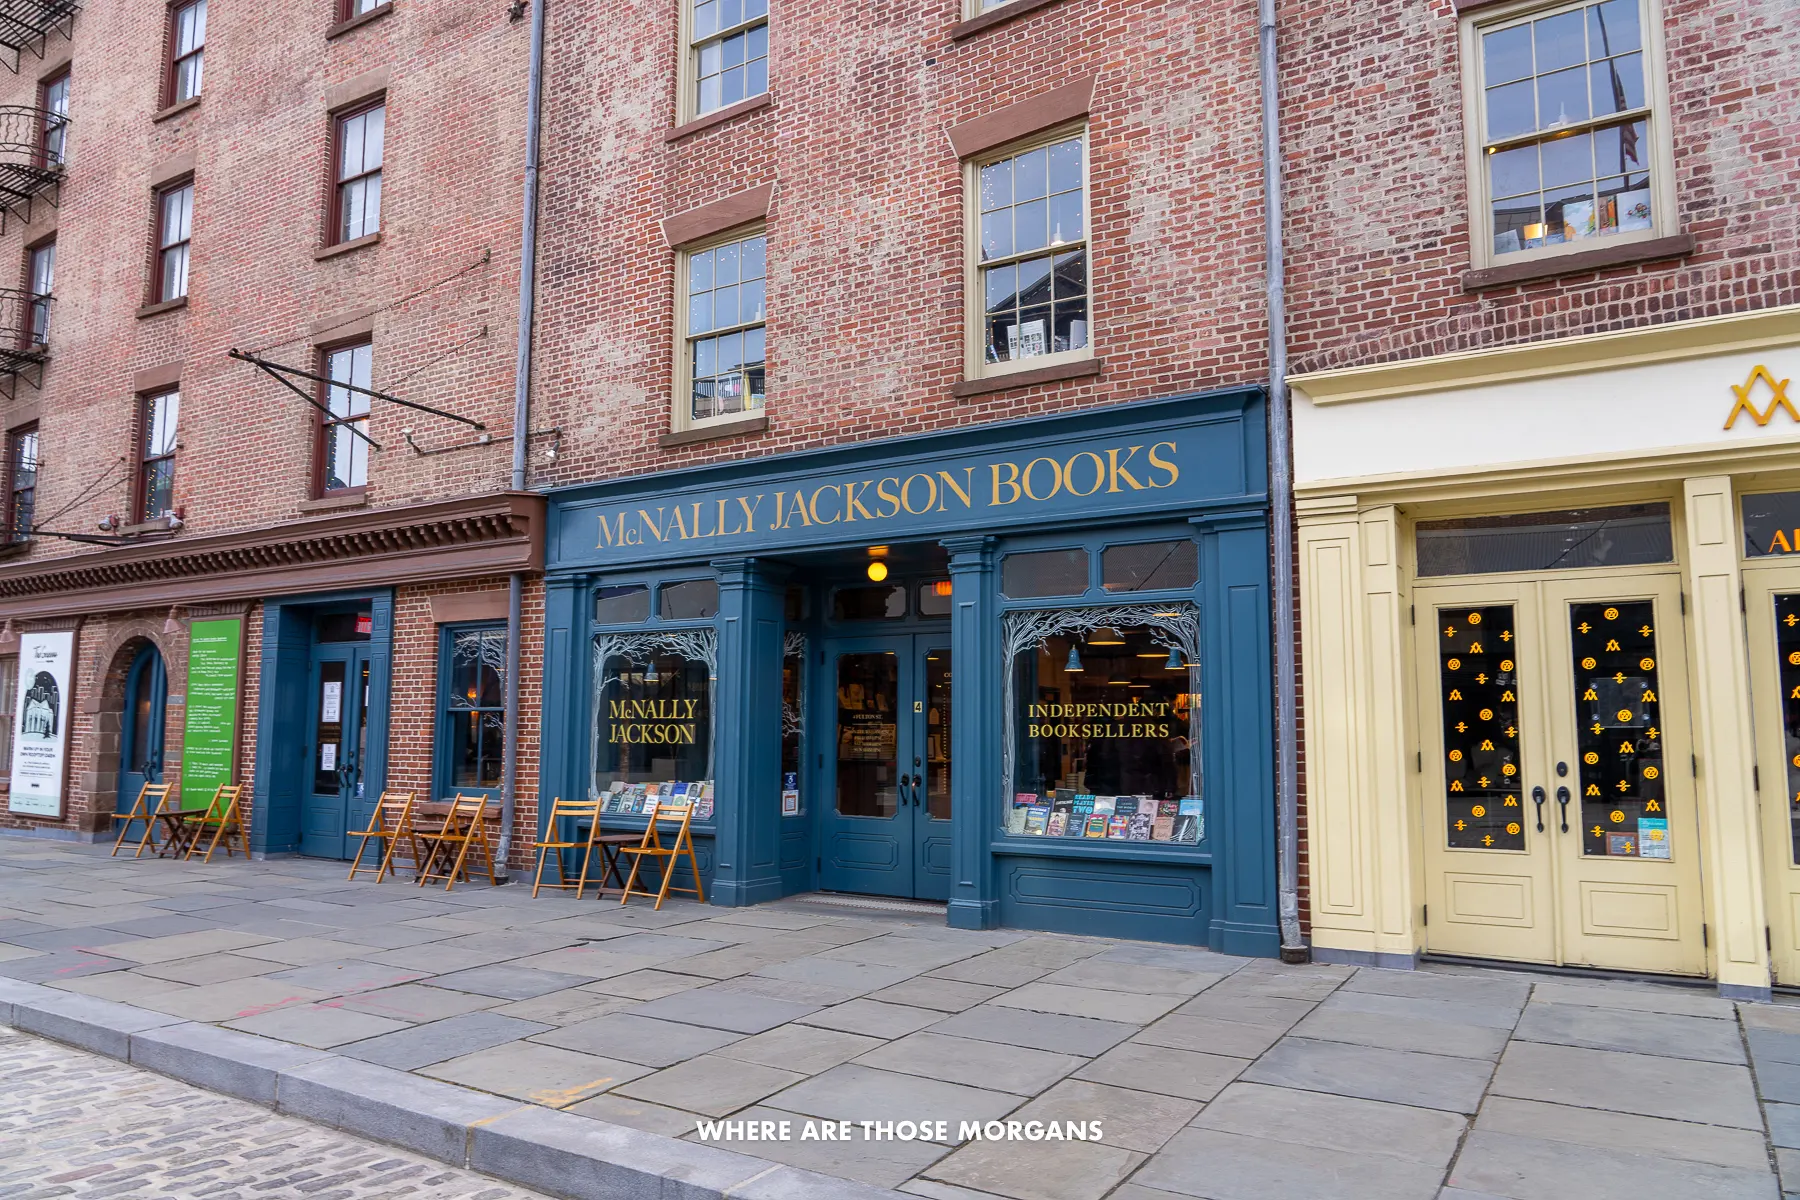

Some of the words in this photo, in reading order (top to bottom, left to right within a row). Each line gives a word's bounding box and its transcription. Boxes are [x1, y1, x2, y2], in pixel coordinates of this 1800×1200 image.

[595, 494, 764, 549] McNALLY
[770, 467, 975, 531] JACKSON
[988, 441, 1180, 507] BOOKS
[609, 699, 698, 720] McNALLY
[915, 702, 921, 712] 4
[1028, 703, 1171, 718] INDEPENDENT
[608, 723, 696, 744] JACKSON
[1028, 723, 1171, 738] BOOKSELLERS
[1072, 806, 1094, 814] TWO
